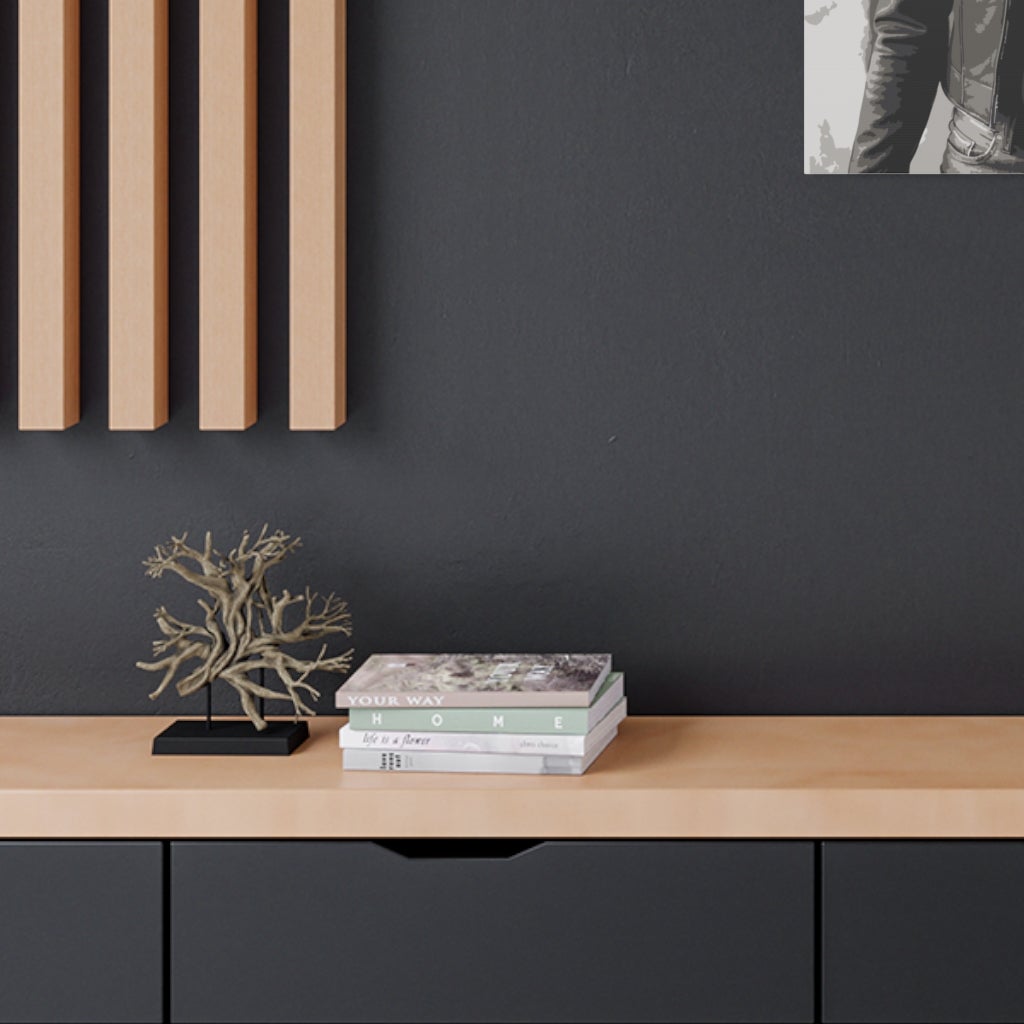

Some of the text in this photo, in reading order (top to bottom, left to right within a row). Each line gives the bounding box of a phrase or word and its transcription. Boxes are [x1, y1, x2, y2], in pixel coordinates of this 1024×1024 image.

[347, 695, 445, 706] YOUR WAY
[372, 712, 563, 730] HOME
[362, 732, 378, 747] life
[401, 734, 431, 748] flower
